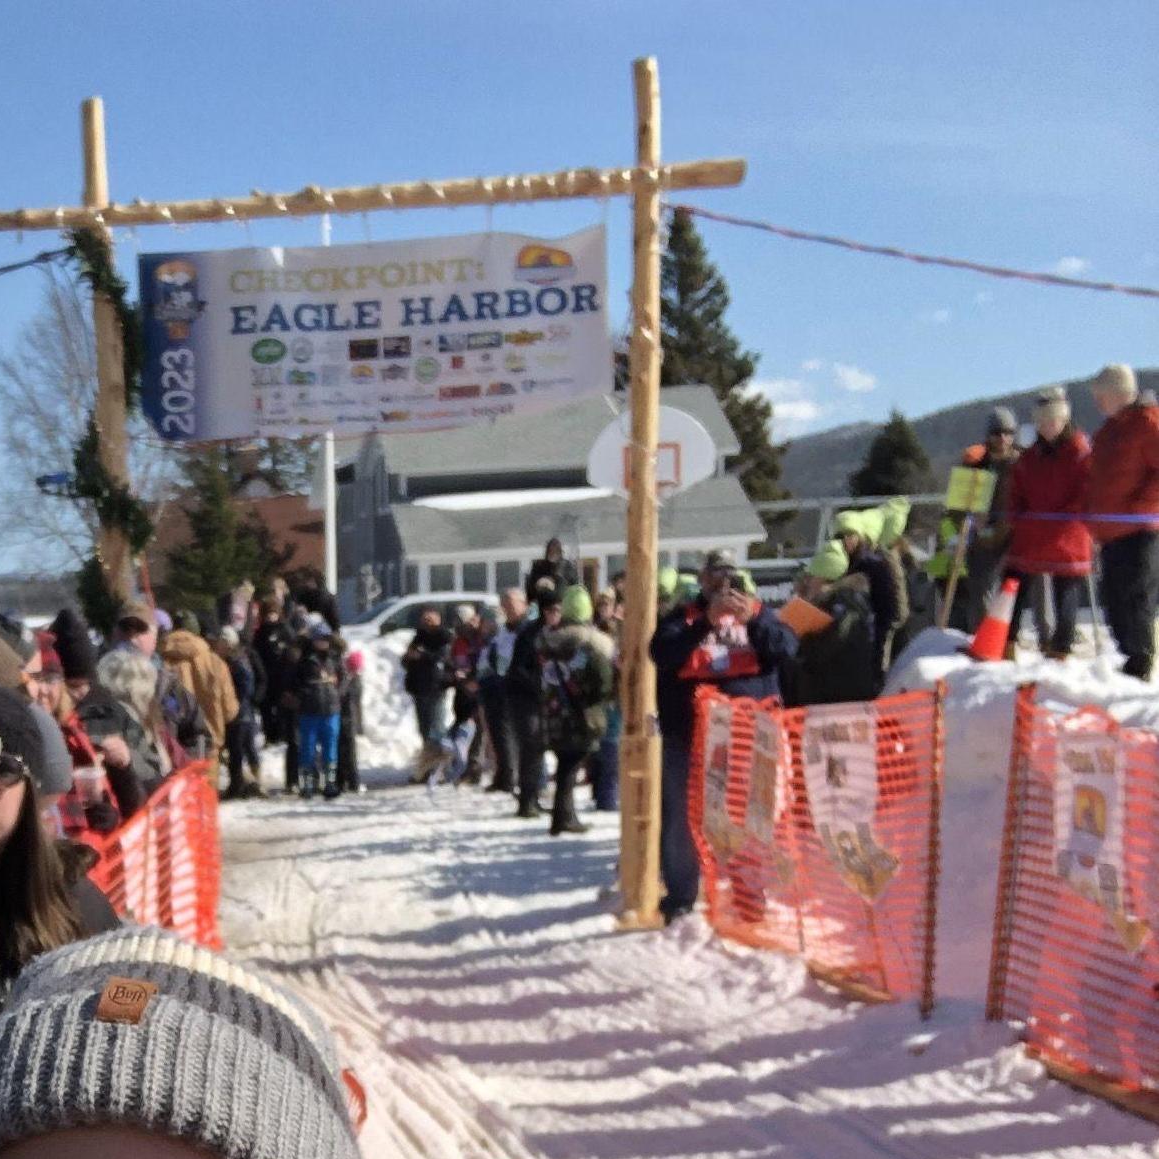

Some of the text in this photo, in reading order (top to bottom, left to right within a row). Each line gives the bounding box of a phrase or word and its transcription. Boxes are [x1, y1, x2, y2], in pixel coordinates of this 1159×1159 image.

[229, 258, 484, 294] CHECKPOINT:
[229, 300, 382, 335] EAGLE
[400, 283, 603, 327] HARBOR
[161, 348, 196, 434] 2023
